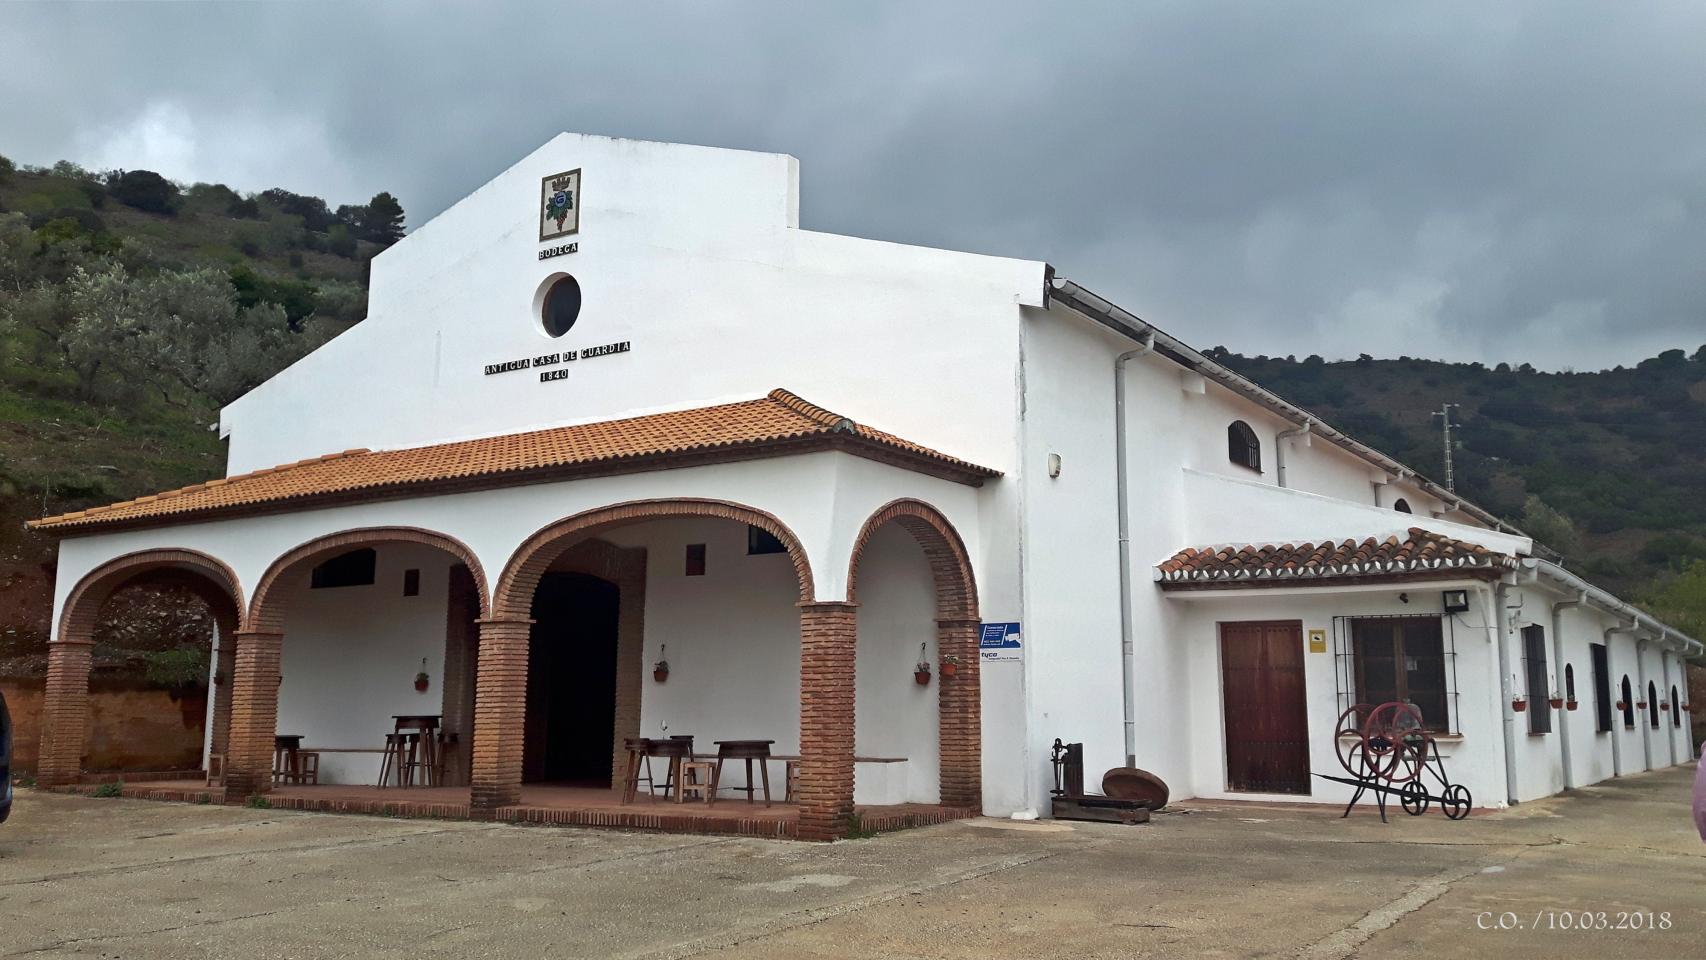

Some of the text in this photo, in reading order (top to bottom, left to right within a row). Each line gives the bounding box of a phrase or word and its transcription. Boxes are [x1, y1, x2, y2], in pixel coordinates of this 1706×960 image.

[539, 243, 578, 259] BODEGA
[485, 342, 630, 374] ANTIGUA CASA DE GUARDIA
[541, 369, 567, 381] 1840
